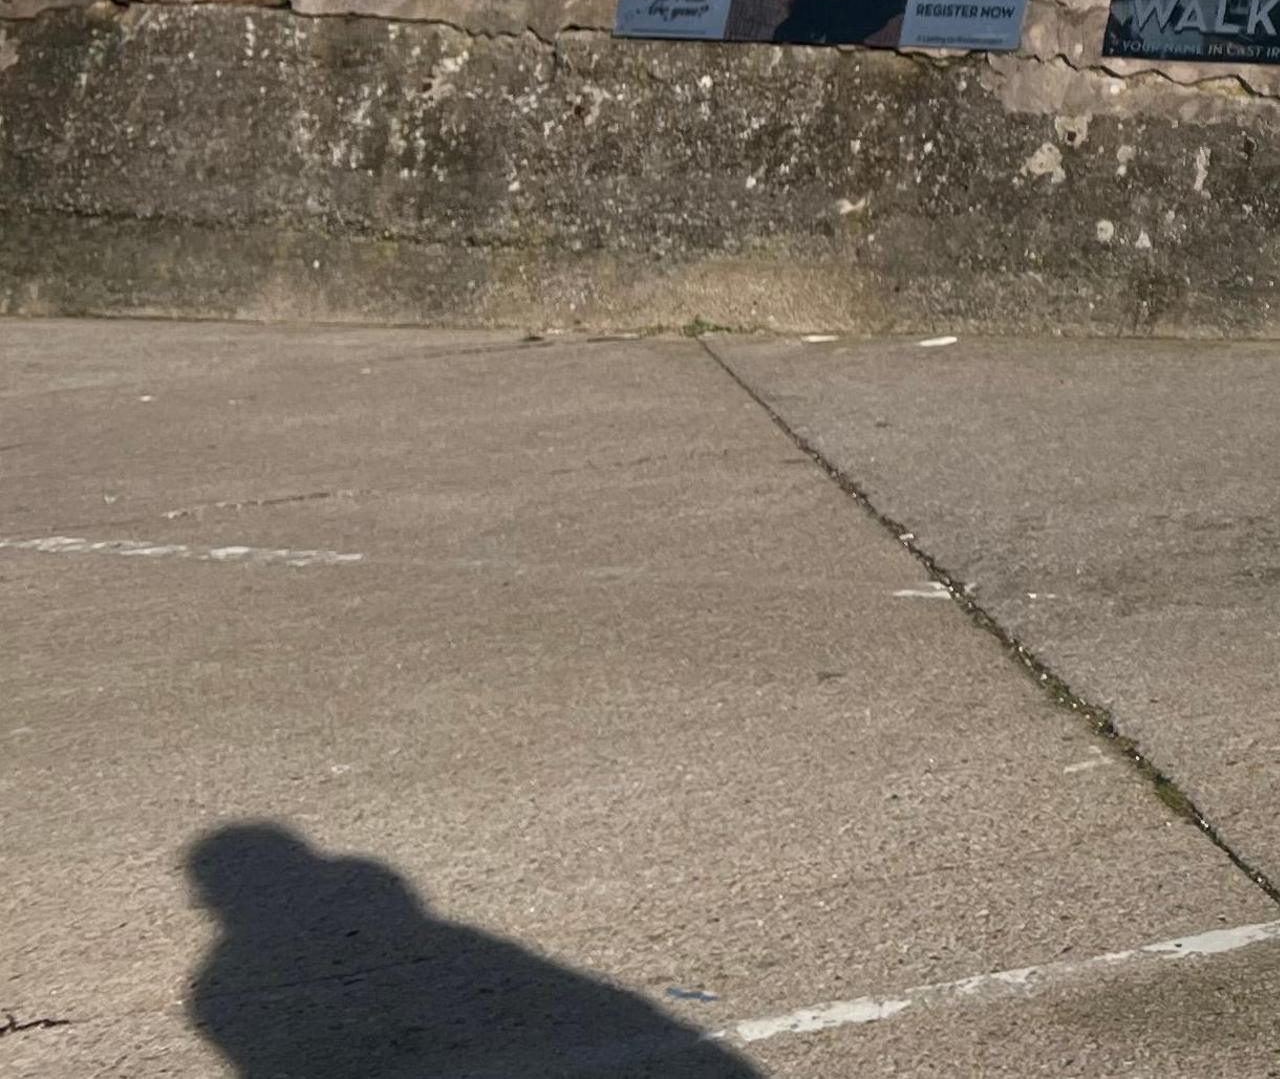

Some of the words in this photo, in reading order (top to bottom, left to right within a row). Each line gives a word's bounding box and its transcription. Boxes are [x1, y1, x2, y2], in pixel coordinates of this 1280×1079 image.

[915, 3, 978, 19] REGISTER
[979, 5, 1016, 19] NOW
[1122, 39, 1158, 53] YOUR
[1165, 42, 1201, 55] NAME
[1207, 42, 1223, 55] IN
[1226, 41, 1265, 57] CAST
